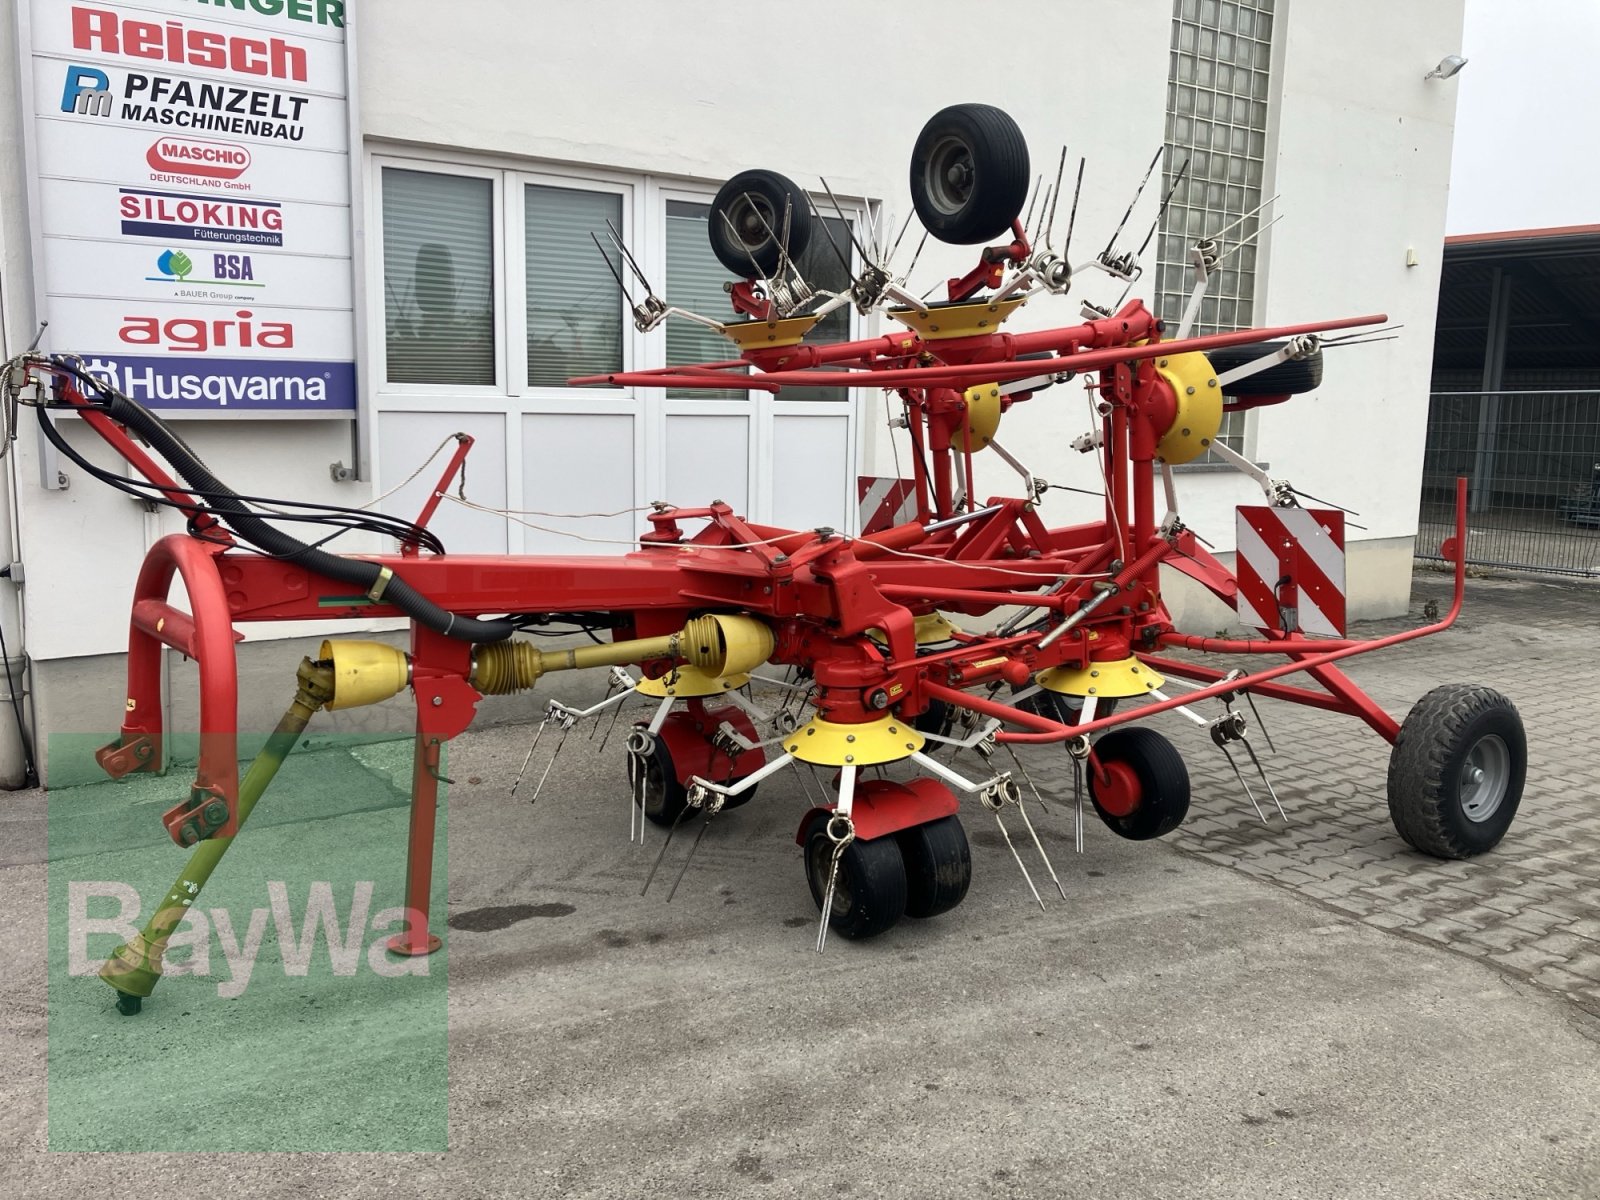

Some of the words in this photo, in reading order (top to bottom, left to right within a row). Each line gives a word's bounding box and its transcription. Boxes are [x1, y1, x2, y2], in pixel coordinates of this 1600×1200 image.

[71, 6, 307, 82] Reisch
[124, 73, 308, 121] PFANZELT
[121, 103, 304, 141] MASCHINENBAU
[162, 143, 246, 165] MASCHIO
[150, 173, 221, 189] DEUTSCHLAND
[224, 181, 251, 190] GmbH
[120, 196, 282, 230] SILOKING
[194, 229, 280, 244] Fütterungstechnik
[214, 254, 254, 281] BSA
[180, 290, 208, 298] BAUER
[210, 292, 233, 300] Group
[119, 310, 294, 352] agria
[125, 366, 327, 406] Husqvarna
